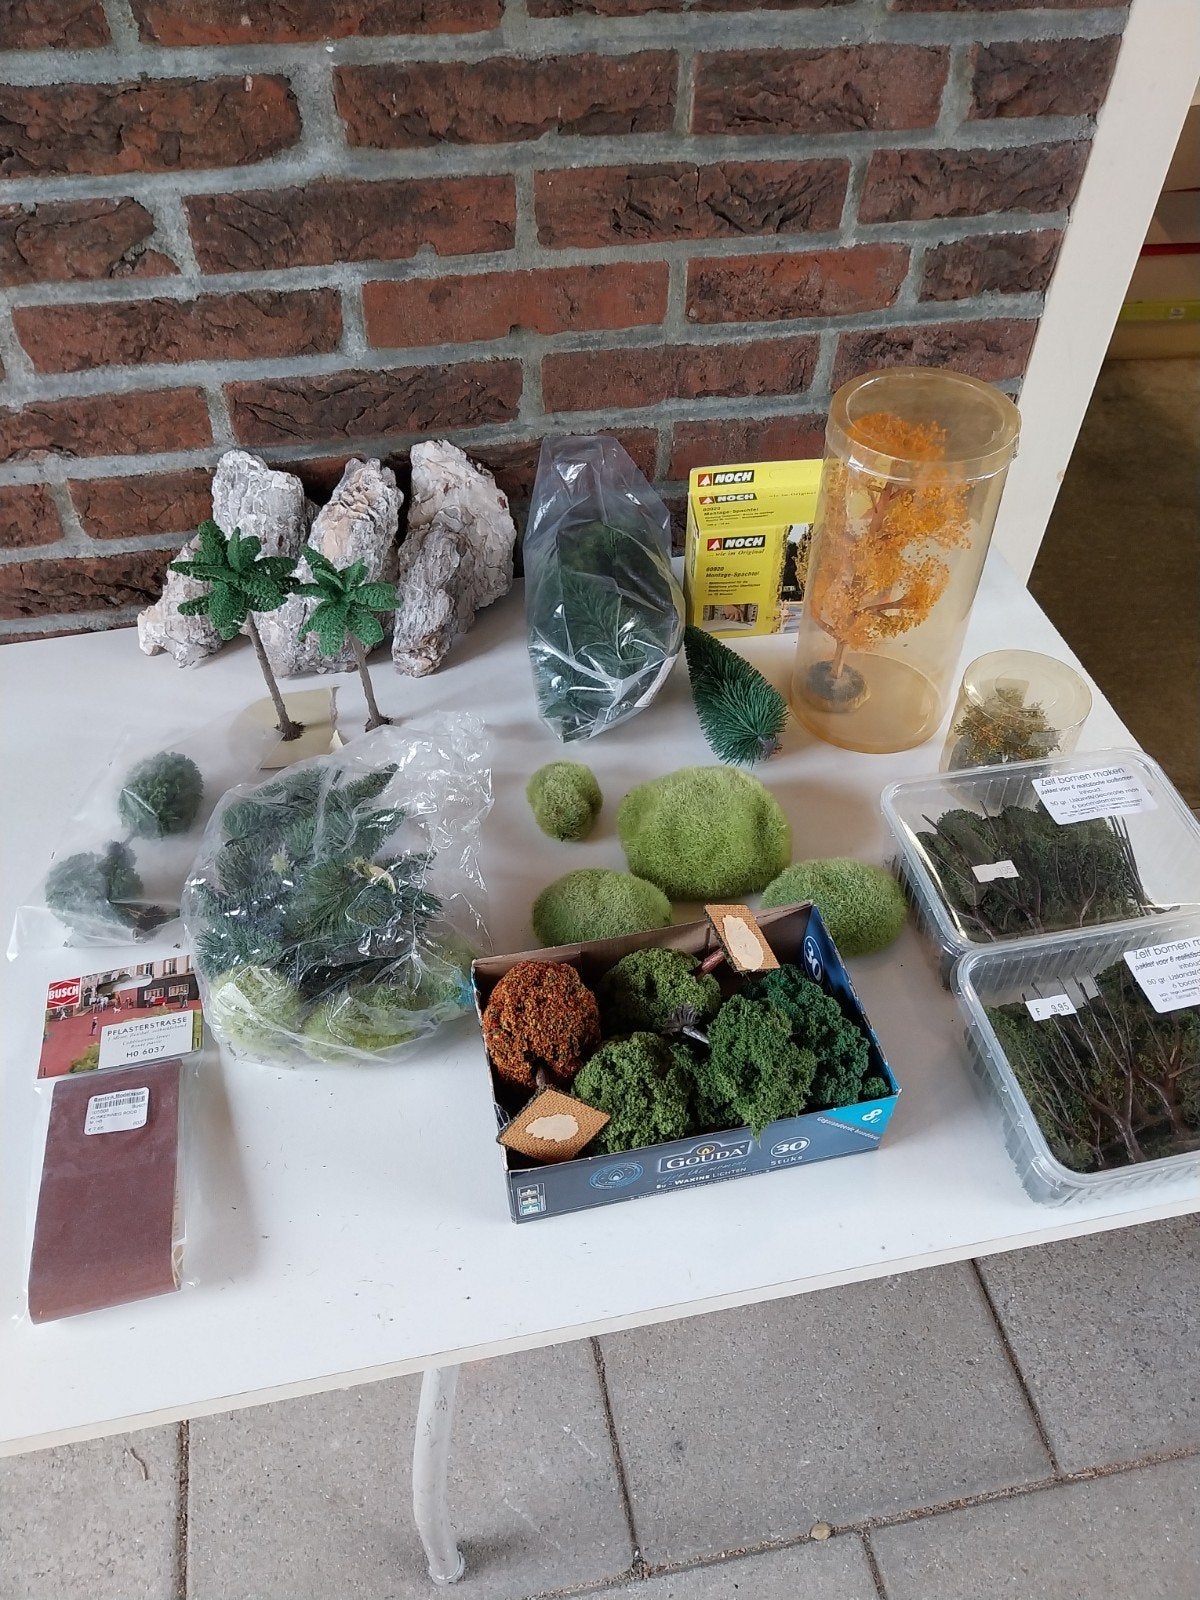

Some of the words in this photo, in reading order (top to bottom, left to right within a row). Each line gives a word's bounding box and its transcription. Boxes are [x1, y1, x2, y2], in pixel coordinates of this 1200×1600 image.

[714, 471, 753, 484] NOCH
[717, 493, 755, 502] NOCH
[724, 536, 764, 548] NOCH
[1041, 778, 1056, 787] Zelf
[1057, 773, 1092, 784] bomen
[1093, 766, 1125, 779] maken
[1134, 948, 1151, 960] Zelf
[1153, 941, 1191, 956] bomen
[804, 941, 823, 982] 30
[1134, 960, 1155, 971] pakket
[1156, 957, 1169, 966] voor
[1146, 978, 1157, 986] 50
[48, 984, 80, 1000] BUSCH
[1035, 1007, 1041, 1016] F
[1050, 1002, 1070, 1013] 9.95
[107, 1016, 187, 1037] PFLASTERSTRASSE
[142, 1045, 166, 1055] 6037
[774, 1139, 808, 1155] 30
[666, 1148, 744, 1169] GOUDA
[675, 1174, 711, 1186] WAXINE
[712, 1167, 747, 1178] LICHTEN
